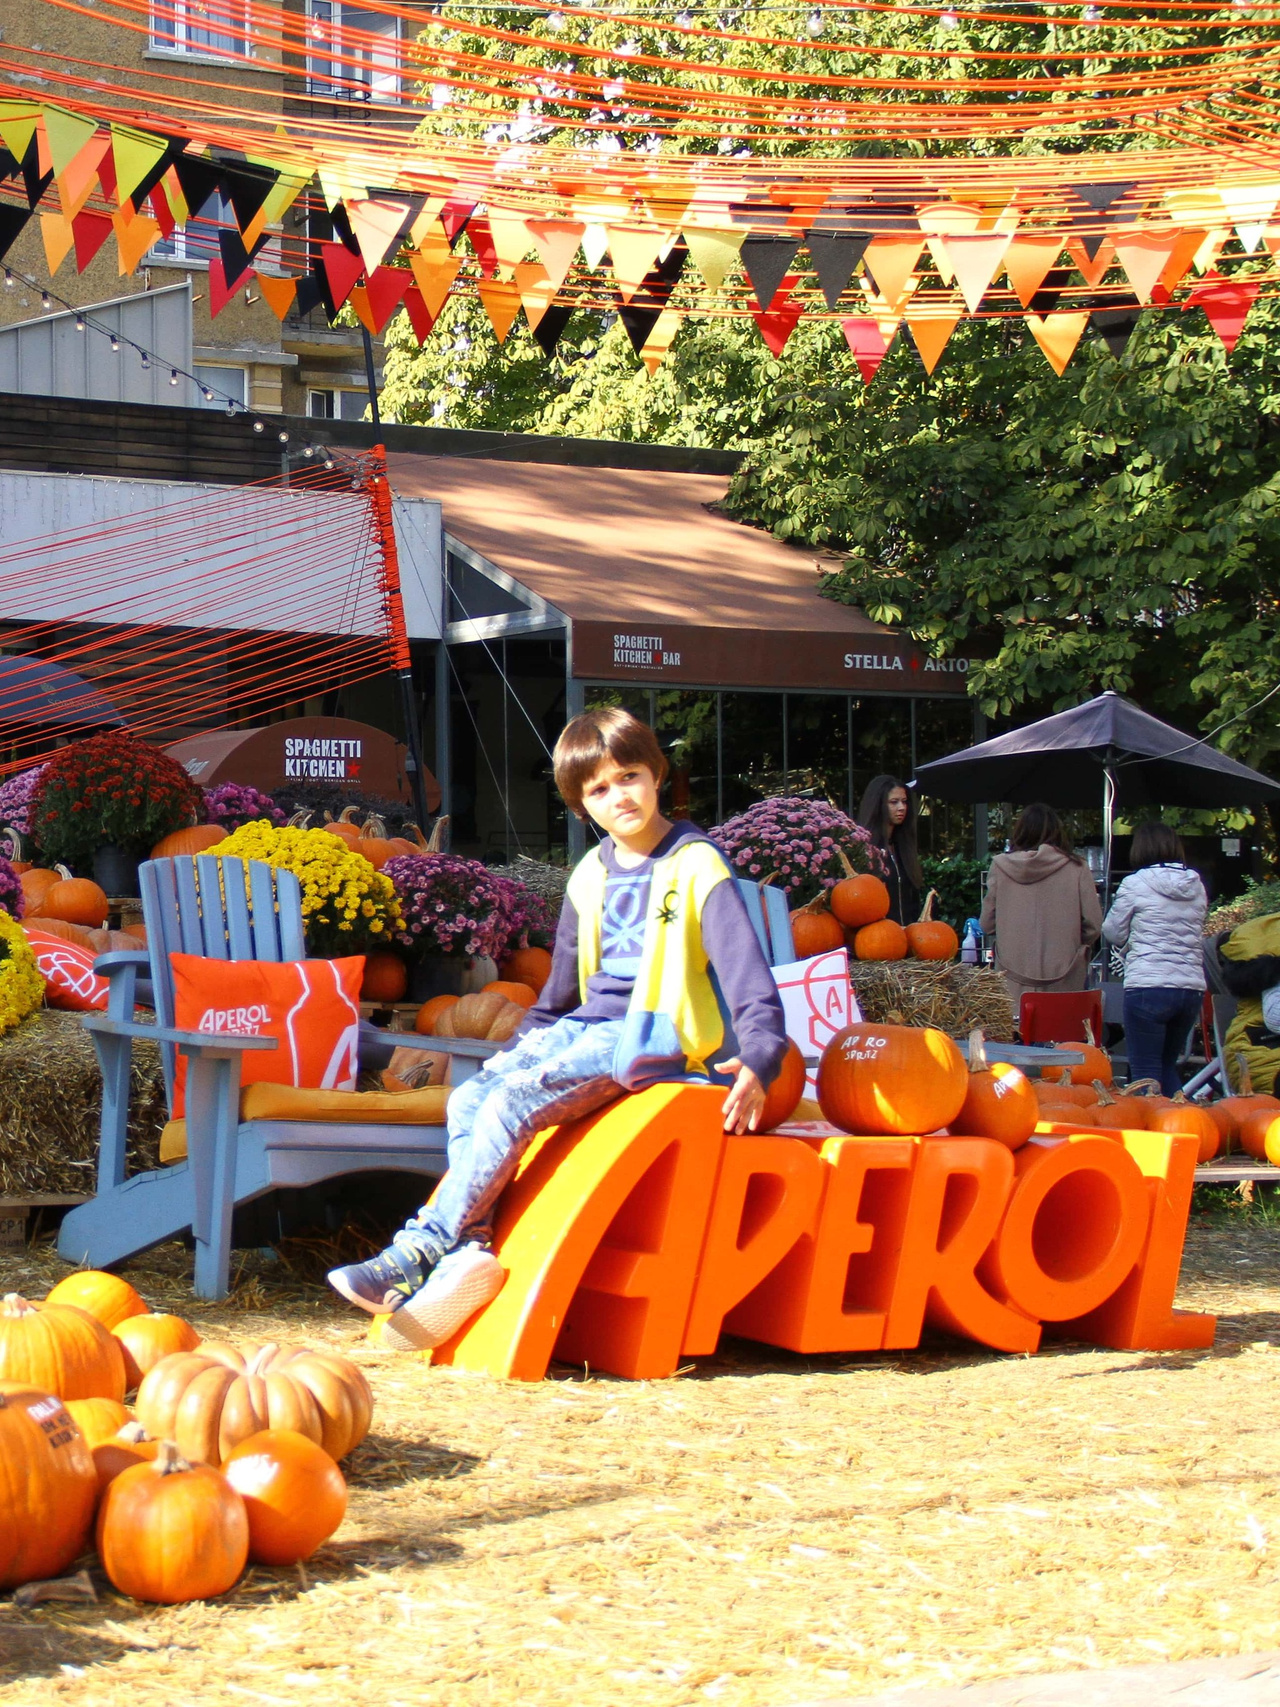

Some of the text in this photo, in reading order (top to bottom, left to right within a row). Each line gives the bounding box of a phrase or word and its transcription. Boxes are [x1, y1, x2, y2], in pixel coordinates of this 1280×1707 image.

[614, 634, 662, 650] SPAGHETTI
[614, 649, 681, 665] KITCHEN BAR
[844, 653, 969, 673] STELLA ARTO
[285, 738, 361, 758] SPAGHETTI
[285, 758, 345, 778] KITCHEN
[198, 1004, 272, 1034] APEROL
[426, 1083, 1217, 1381] APEROL
